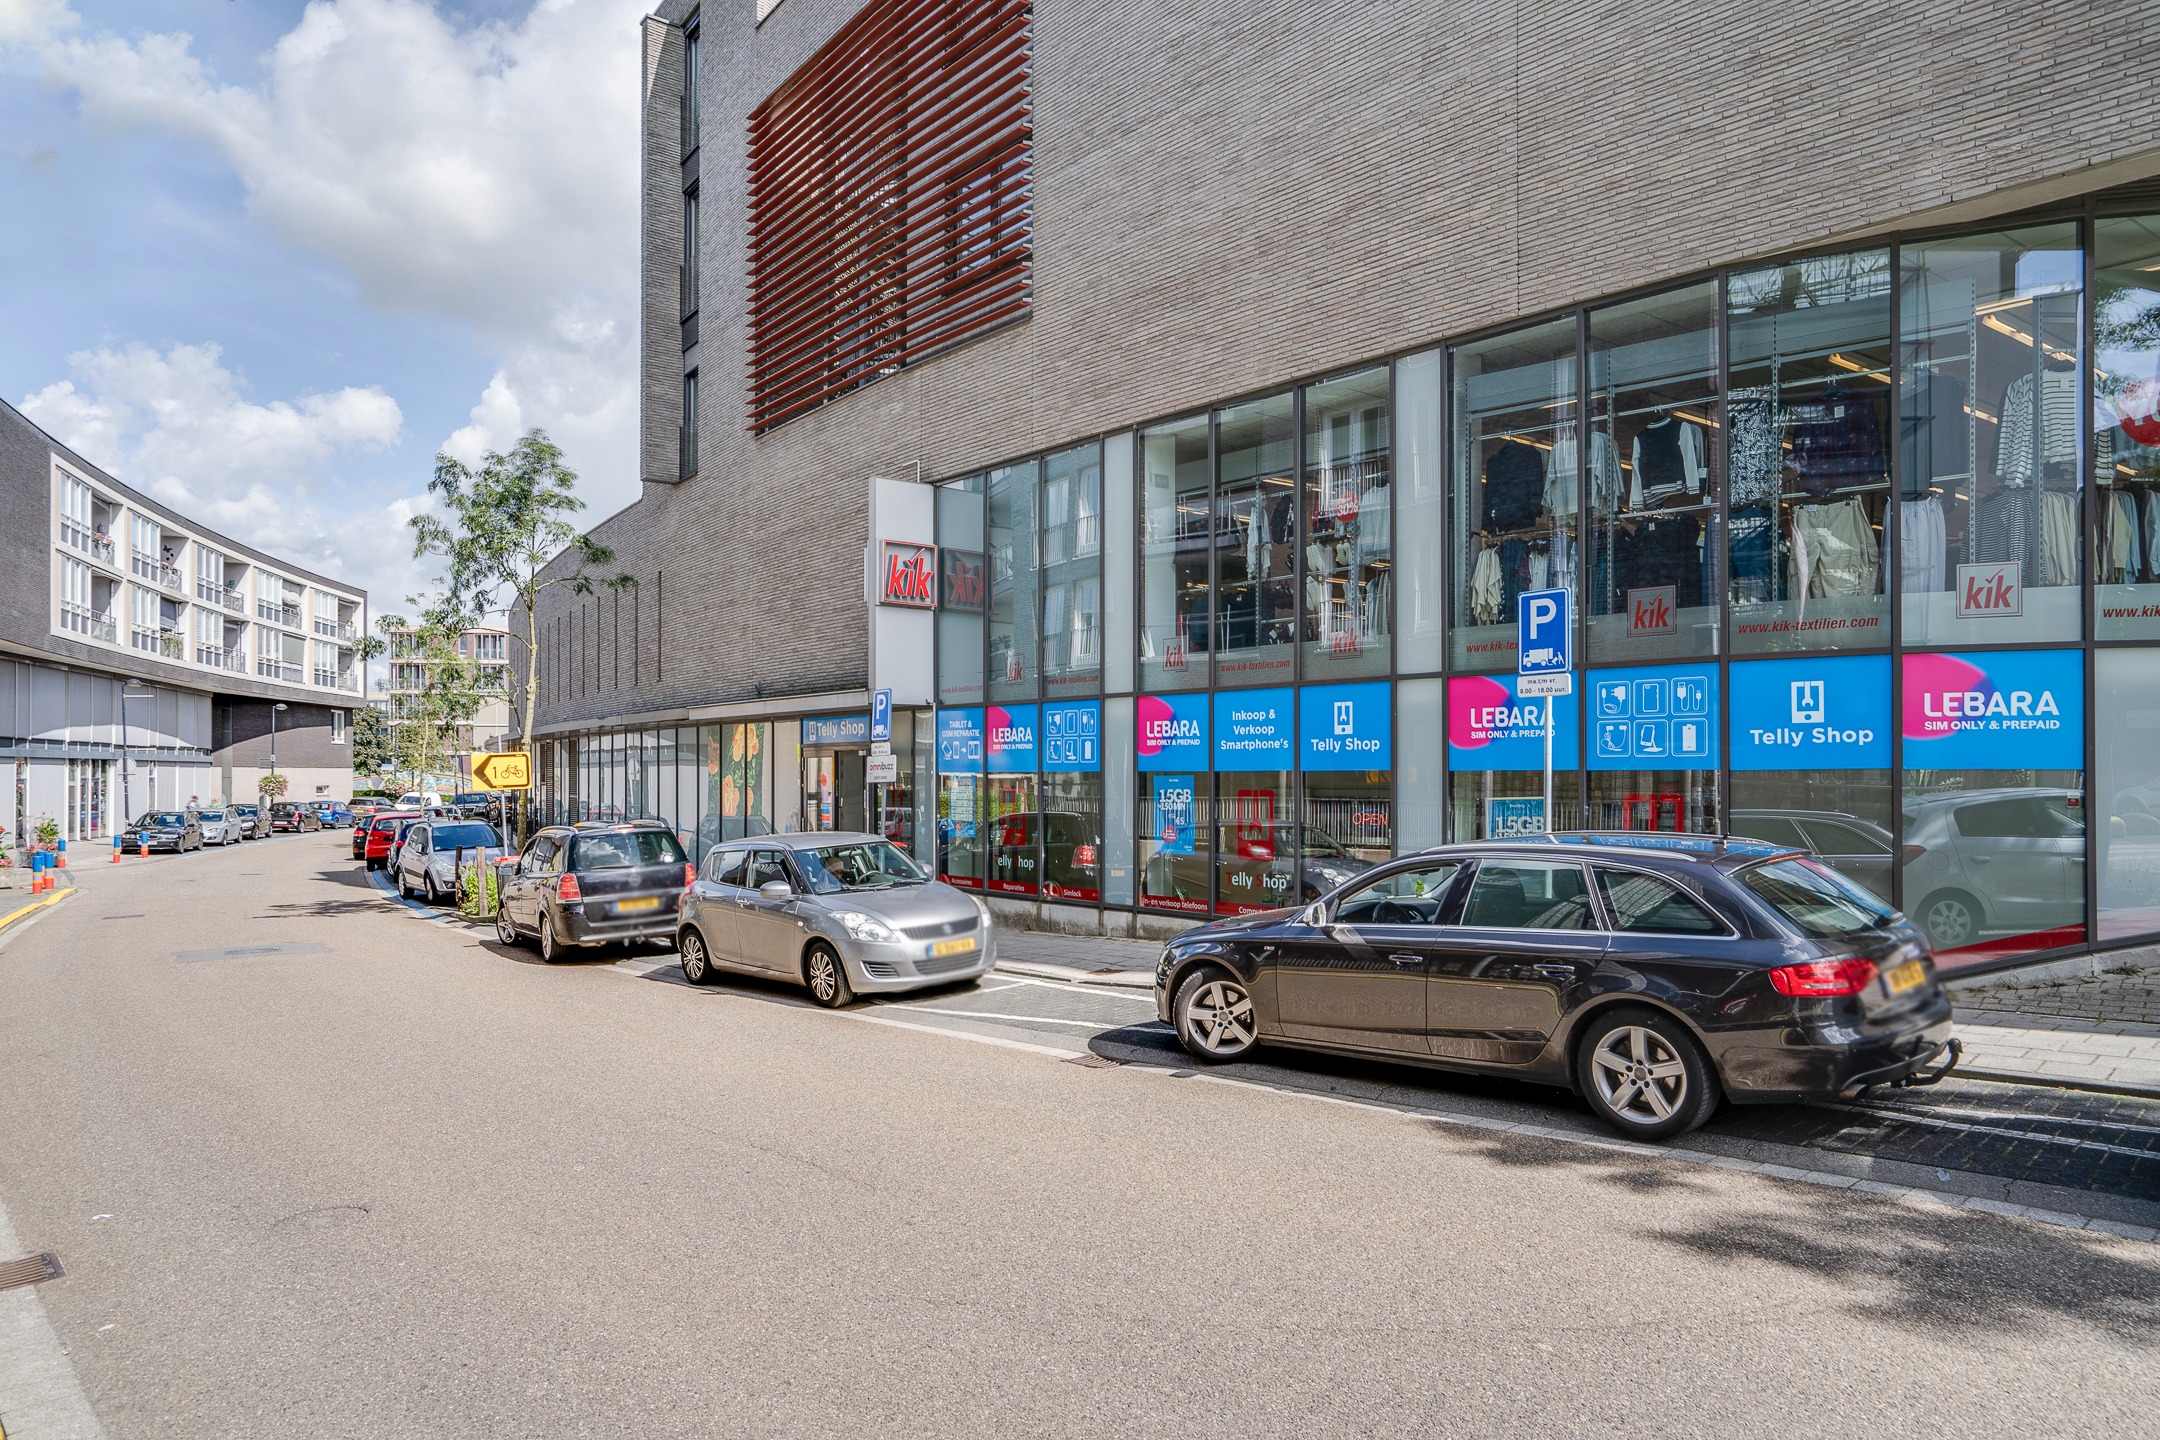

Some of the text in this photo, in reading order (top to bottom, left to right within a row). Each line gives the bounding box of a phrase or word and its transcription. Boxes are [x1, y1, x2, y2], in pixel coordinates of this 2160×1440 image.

[888, 548, 933, 598] kik
[1964, 568, 2014, 609] kik
[1633, 592, 1669, 629] kik
[1530, 598, 1556, 639] P
[1738, 617, 1879, 633] www.kik-textilien.com
[1333, 627, 1358, 654] kik
[1466, 641, 1519, 653] www.kik-tex
[1165, 640, 1184, 668] kik
[1220, 659, 1291, 673] www.kik-textilien.com
[876, 694, 886, 719] P
[1924, 691, 2060, 717] LEBARA
[1232, 709, 1276, 722] Inkoop &
[817, 720, 865, 738] Telly Shop
[949, 719, 973, 728] TABLET &
[1146, 719, 1200, 737] LEBARA
[1233, 724, 1275, 736] Verkoop
[1924, 719, 2060, 730] SIM ONLY & PREPAID
[953, 729, 981, 737] REPARATIE
[992, 727, 1033, 743] LEBARA
[1471, 730, 1555, 739] SIM ONLY & PREPAD
[1750, 727, 1874, 747] Telly Shop
[1177, 738, 1200, 746] PREPAID
[1220, 738, 1289, 751] Smartphone's
[1311, 737, 1381, 753] Telly Shop
[492, 766, 497, 779] 1
[869, 762, 894, 771] omnibuzz
[1159, 788, 1192, 803] 15GB
[1352, 812, 1388, 825] OPEN
[1495, 815, 1545, 833] 15GB
[994, 854, 1034, 871] Telly Shop
[1003, 883, 1025, 892] Reparaties
[1225, 871, 1287, 892] Telly Shop
[1063, 888, 1082, 897] Simlock
[1158, 899, 1181, 909] verkoop
[1182, 899, 1208, 911] telefoons
